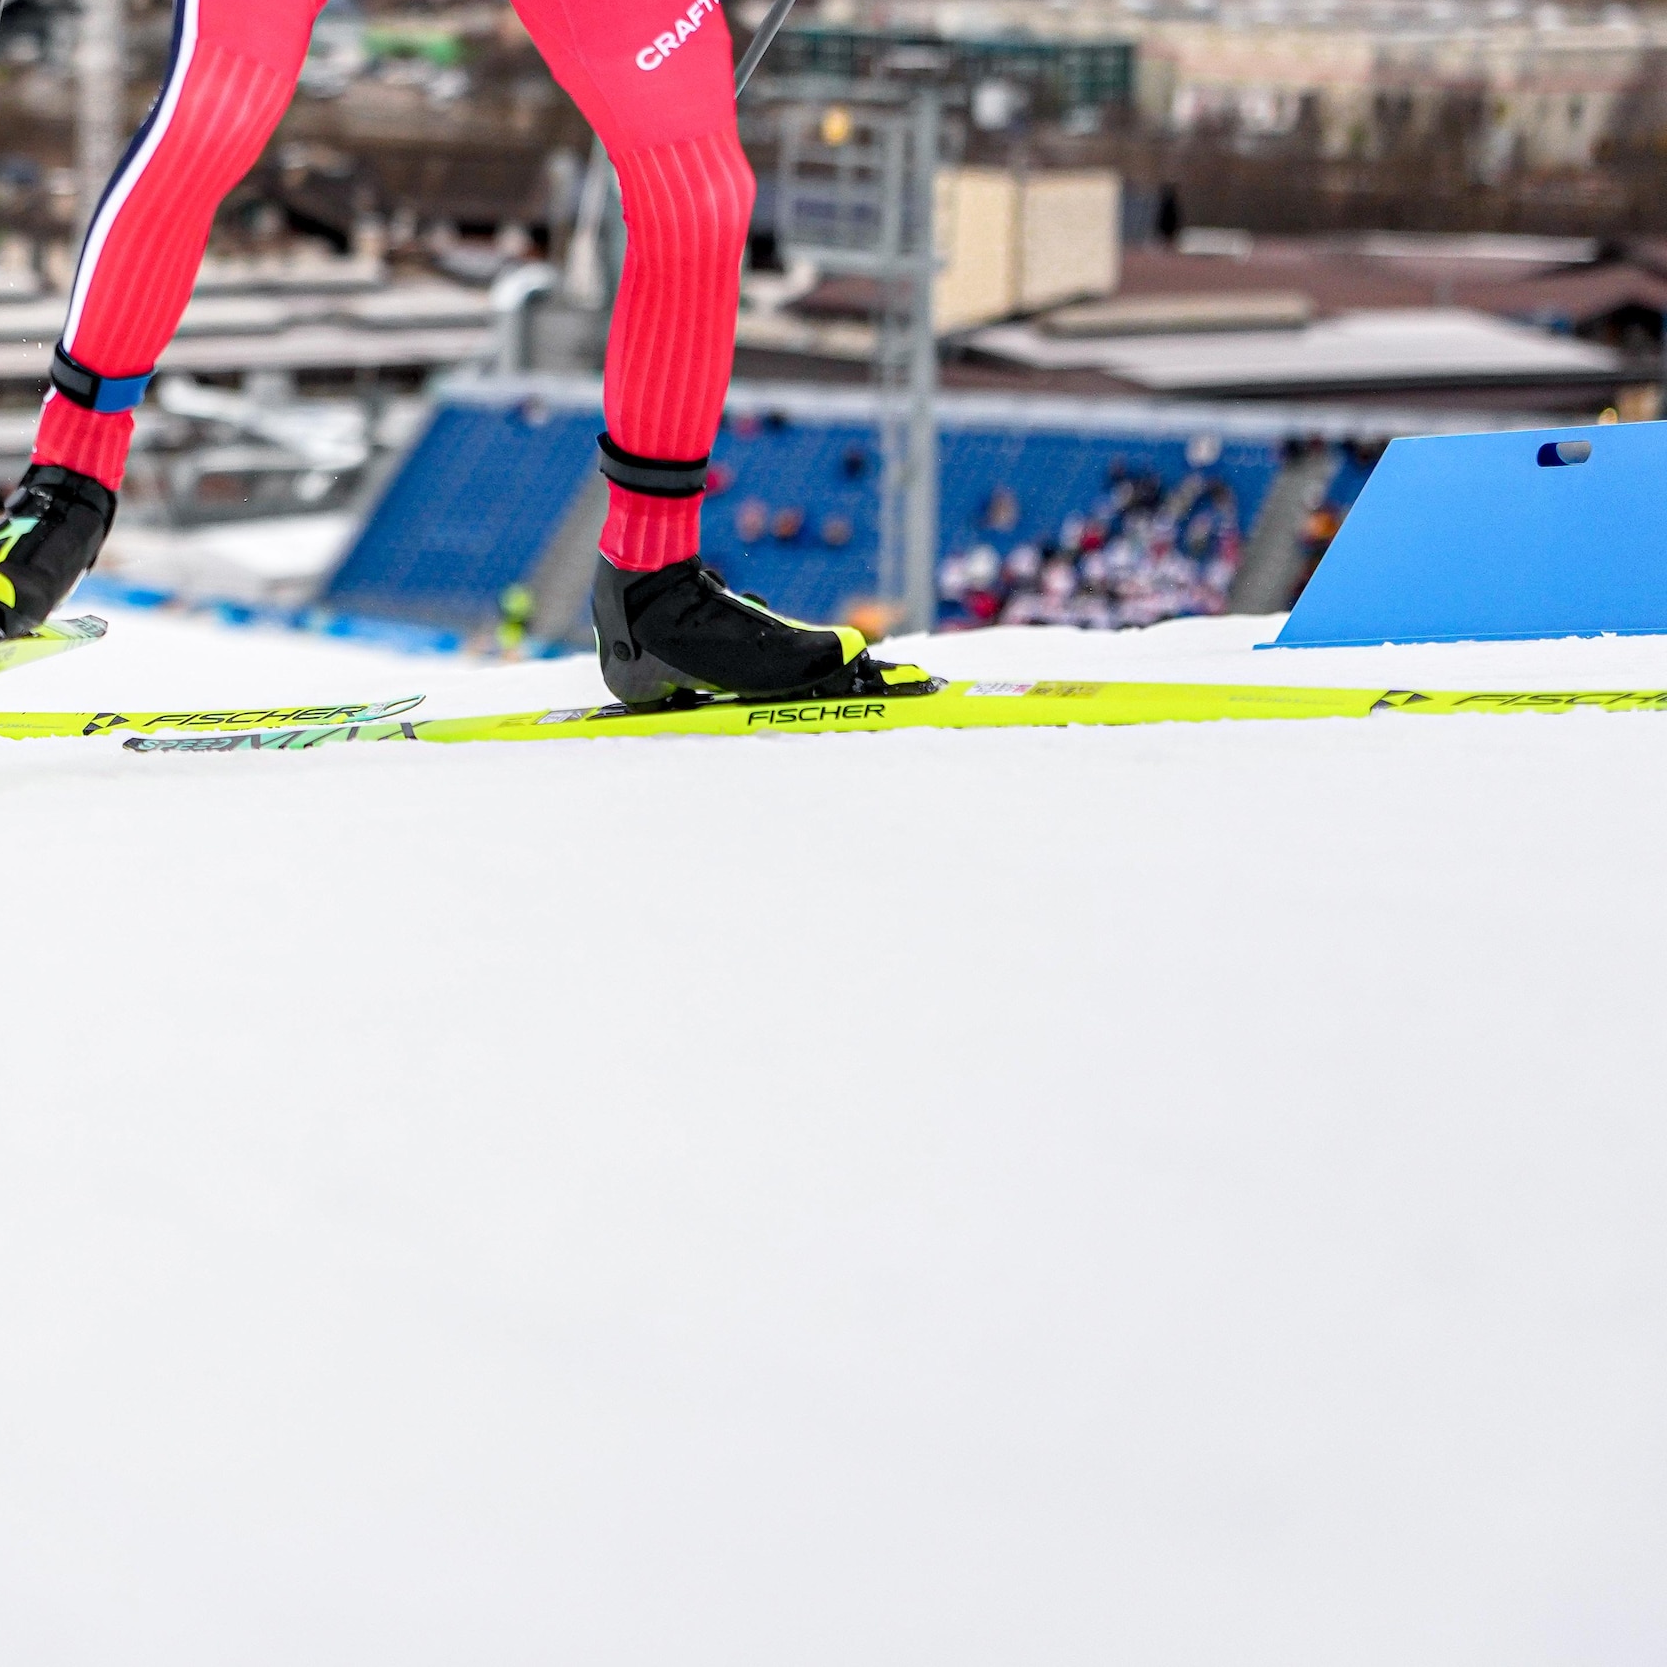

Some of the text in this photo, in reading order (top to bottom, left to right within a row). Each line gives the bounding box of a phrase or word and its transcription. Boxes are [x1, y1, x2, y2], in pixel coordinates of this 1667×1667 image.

[143, 705, 369, 726] FISCHER
[747, 704, 885, 726] FISCHER
[138, 737, 233, 751] SPEED
